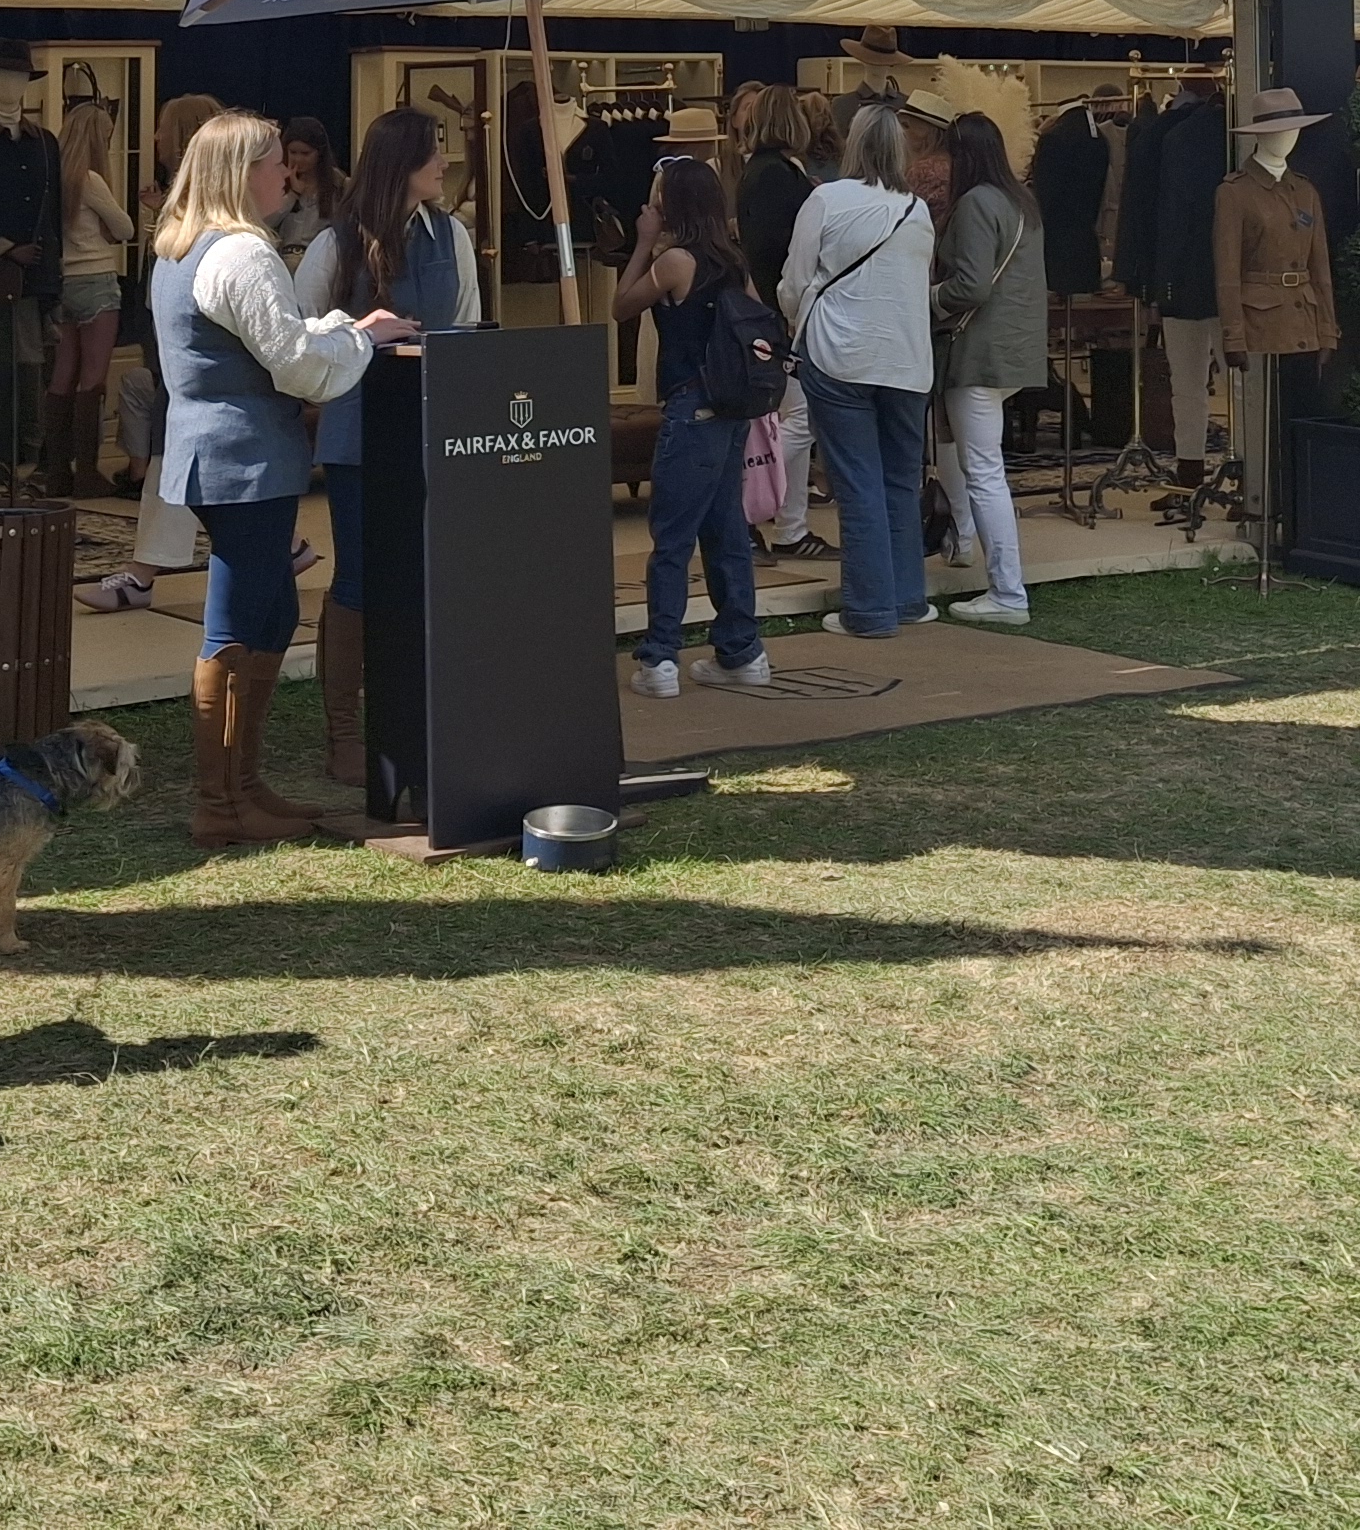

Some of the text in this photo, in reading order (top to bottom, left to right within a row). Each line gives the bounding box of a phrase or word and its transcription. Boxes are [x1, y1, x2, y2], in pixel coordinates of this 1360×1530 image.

[445, 426, 597, 457] FAIRFAX & FAVOR
[501, 451, 542, 465] ENGLAND
[743, 451, 777, 470] eart
